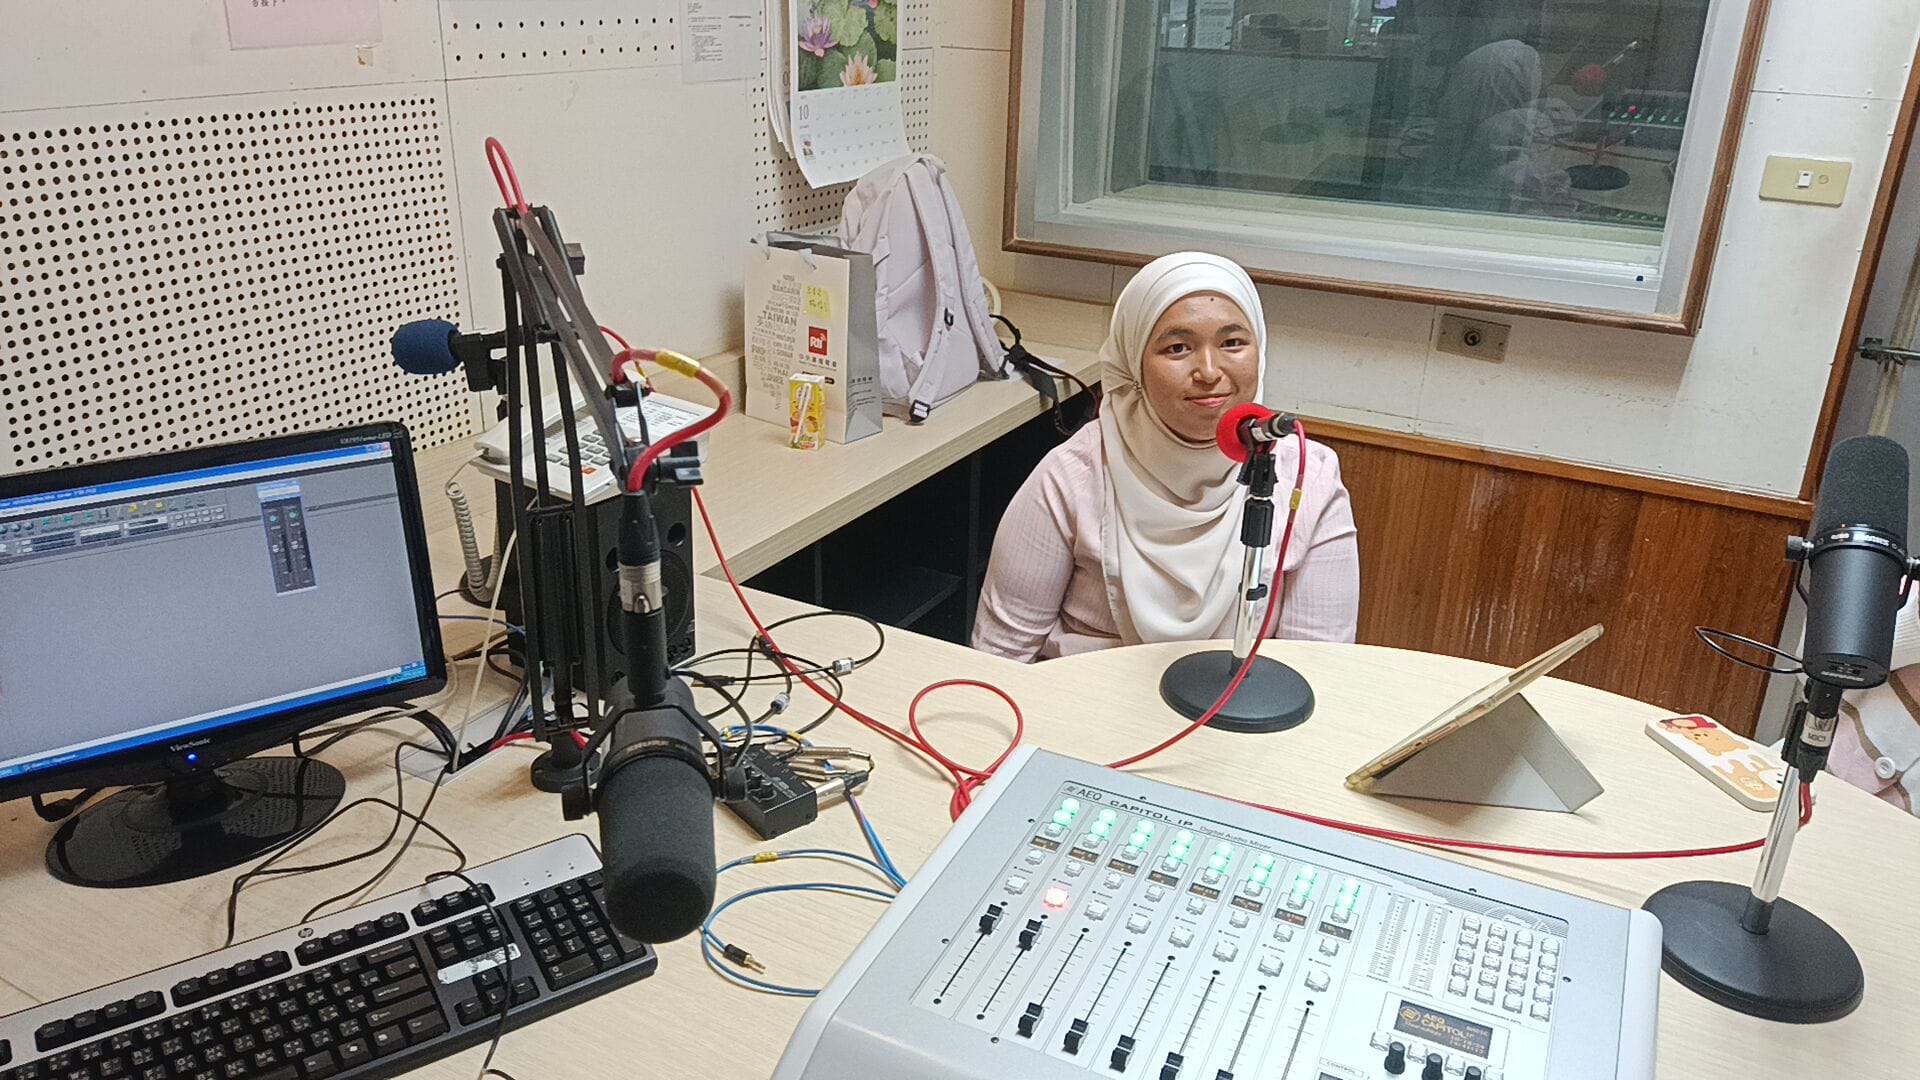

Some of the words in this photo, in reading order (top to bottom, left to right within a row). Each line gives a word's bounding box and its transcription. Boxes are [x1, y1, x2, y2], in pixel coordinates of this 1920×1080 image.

[799, 104, 809, 120] 10
[762, 310, 798, 327] TAIWAN
[1077, 788, 1102, 801] AEQ
[1110, 799, 1172, 823] CAPITOL
[1177, 819, 1194, 828] IP
[1200, 826, 1225, 836] Digital
[1422, 1013, 1446, 1024] AEQ
[1420, 1019, 1466, 1039] CAPITOL
